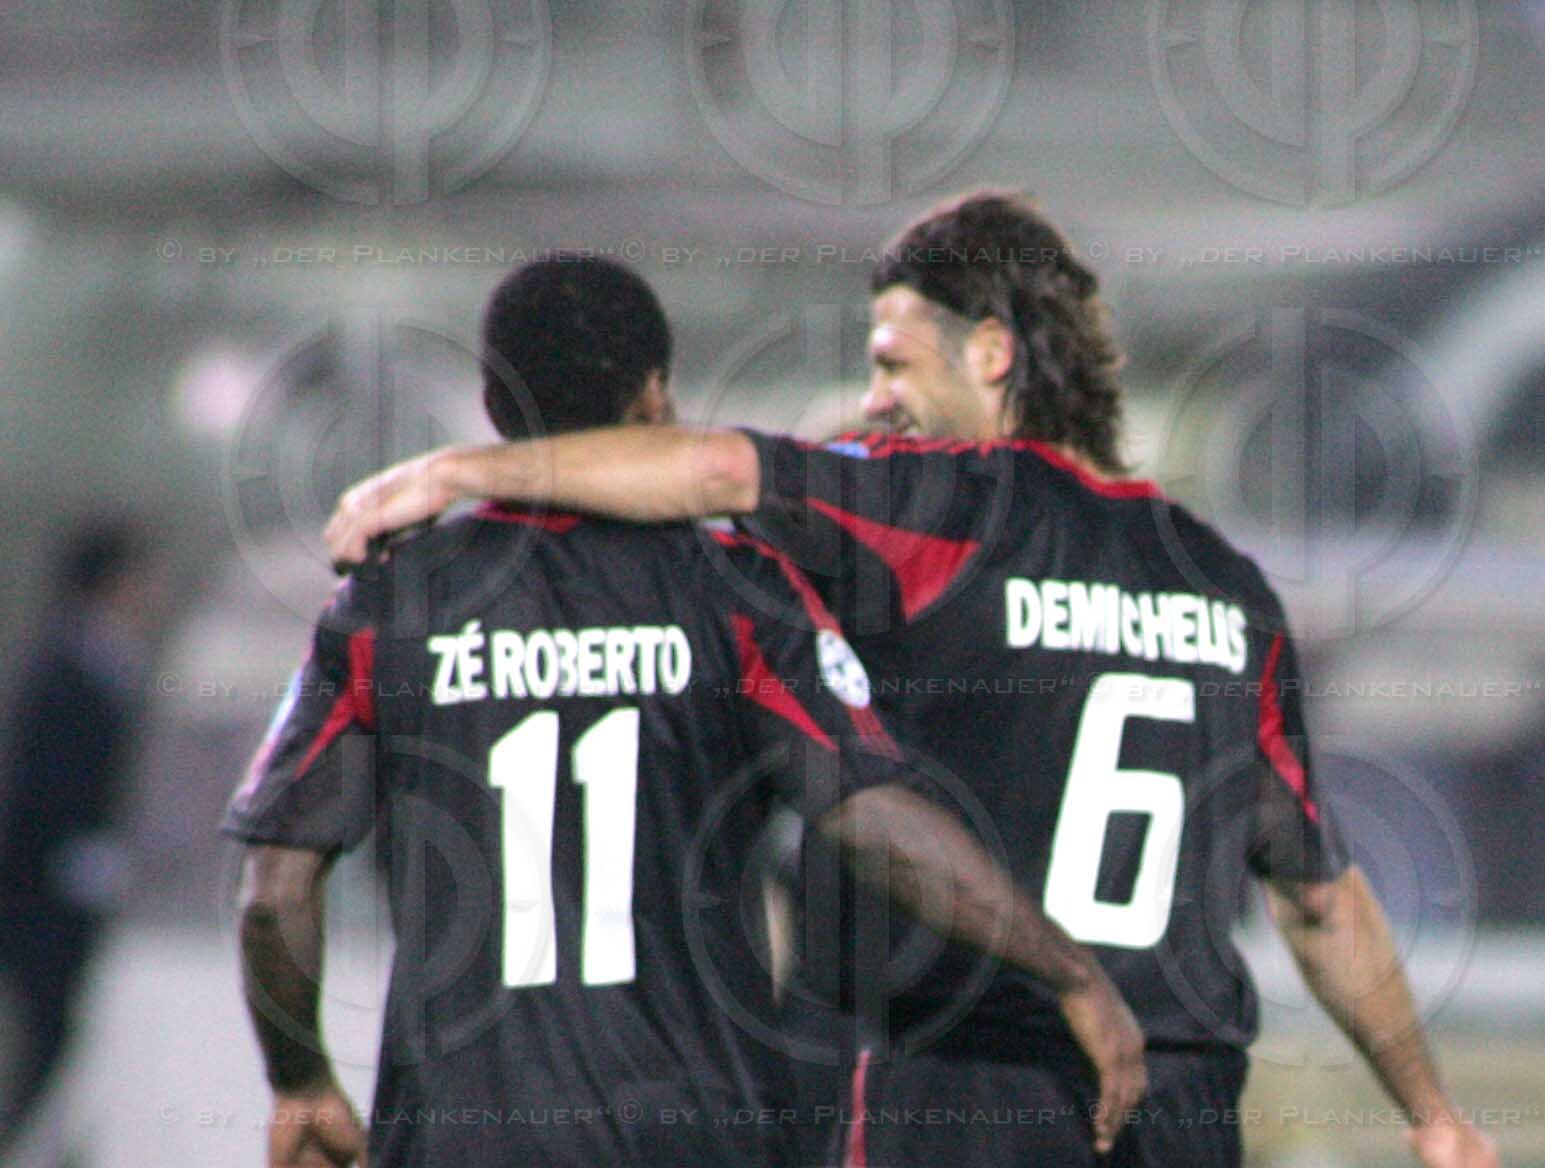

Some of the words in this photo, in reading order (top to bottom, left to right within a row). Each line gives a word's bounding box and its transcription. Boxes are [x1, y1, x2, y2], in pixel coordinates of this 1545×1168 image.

[427, 620, 487, 704] ZÉ
[490, 624, 692, 699] ROBERTO
[1005, 577, 1248, 674] DEMICHELIS
[489, 709, 639, 987] 11
[1045, 674, 1194, 947] 6
